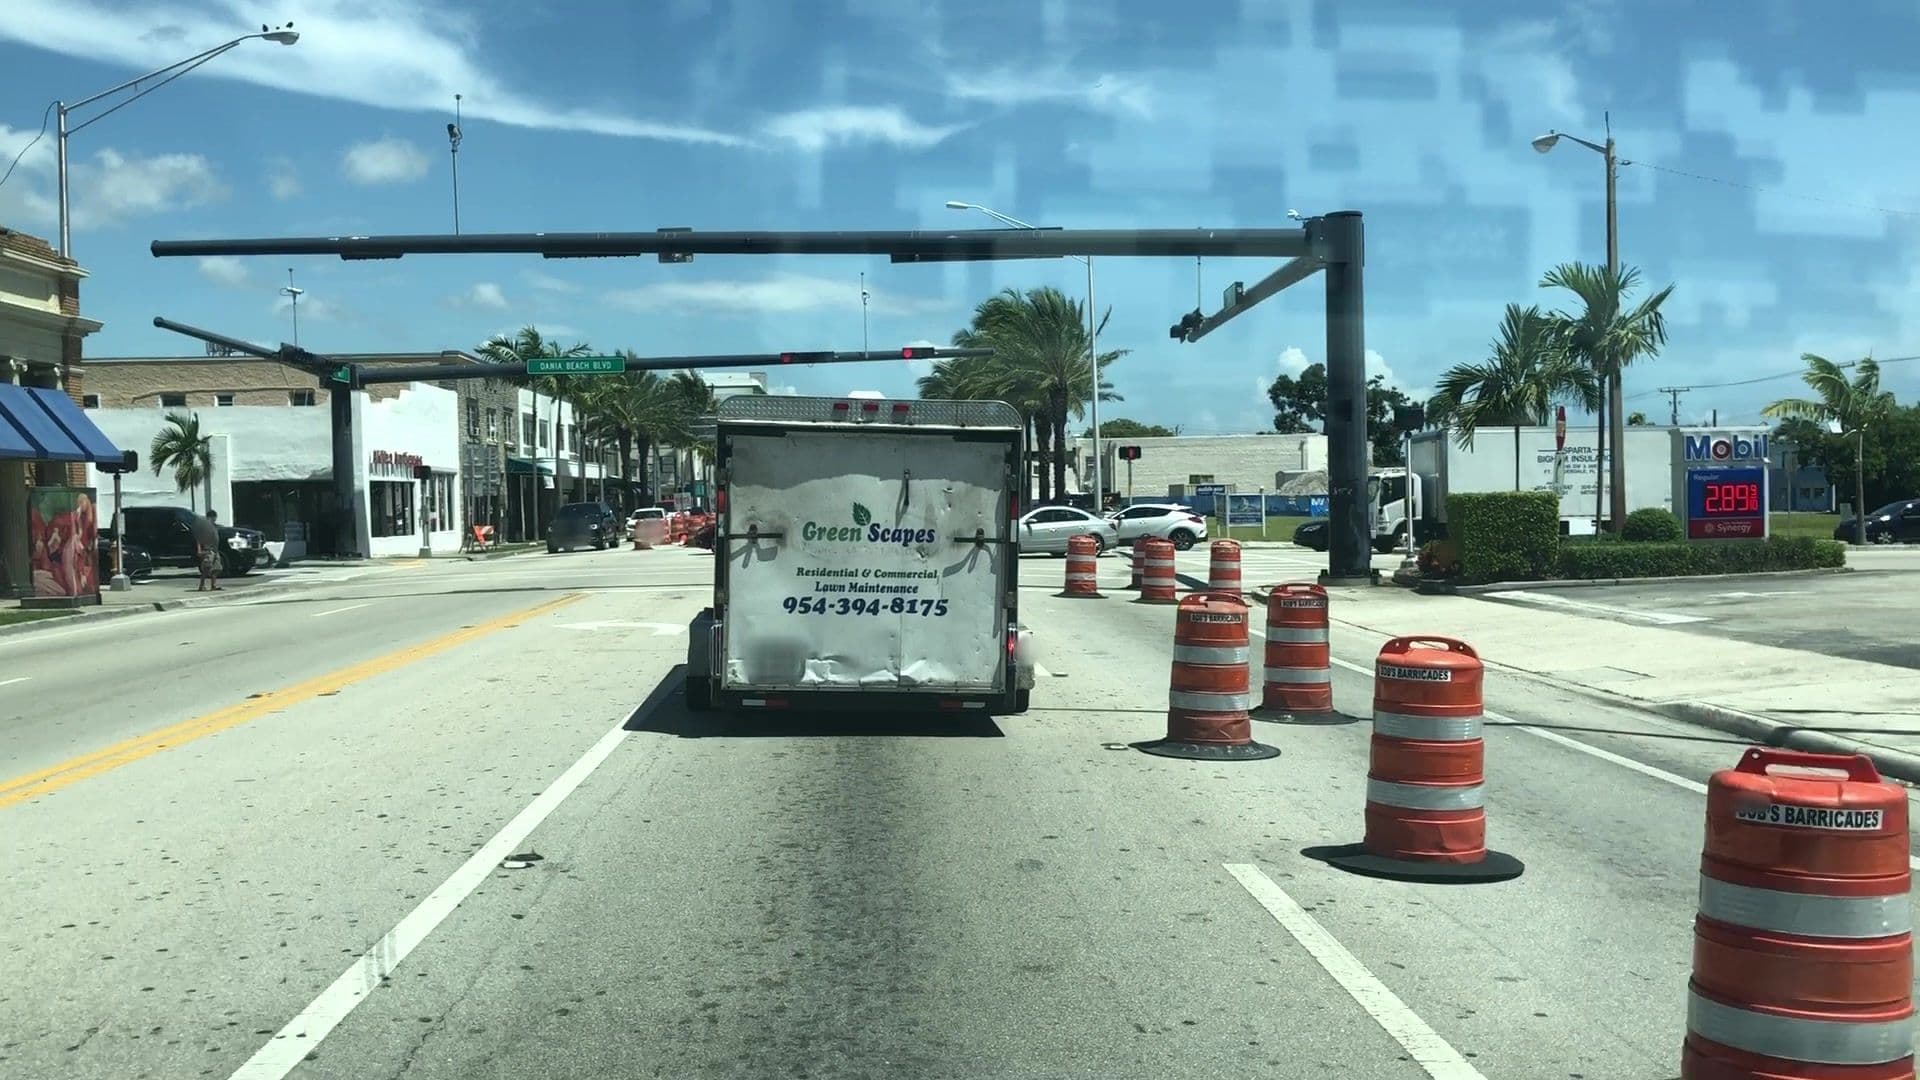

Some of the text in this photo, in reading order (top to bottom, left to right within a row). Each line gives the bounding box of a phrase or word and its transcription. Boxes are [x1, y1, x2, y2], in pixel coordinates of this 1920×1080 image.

[540, 361, 612, 370] DANIA BEACH BLVD
[1563, 446, 1592, 454] SPARTA
[1685, 433, 1768, 461] Mobil
[1693, 473, 1720, 481] Regular
[802, 521, 936, 547] Green Scapes
[1717, 523, 1752, 534] Synergy
[796, 567, 938, 580] Residential & Commercial
[815, 581, 919, 594] Lawn Maintenance
[783, 596, 949, 617] 954-394-8175
[1397, 669, 1449, 681] BARRICADES
[1785, 806, 1879, 829] BARRICADES
